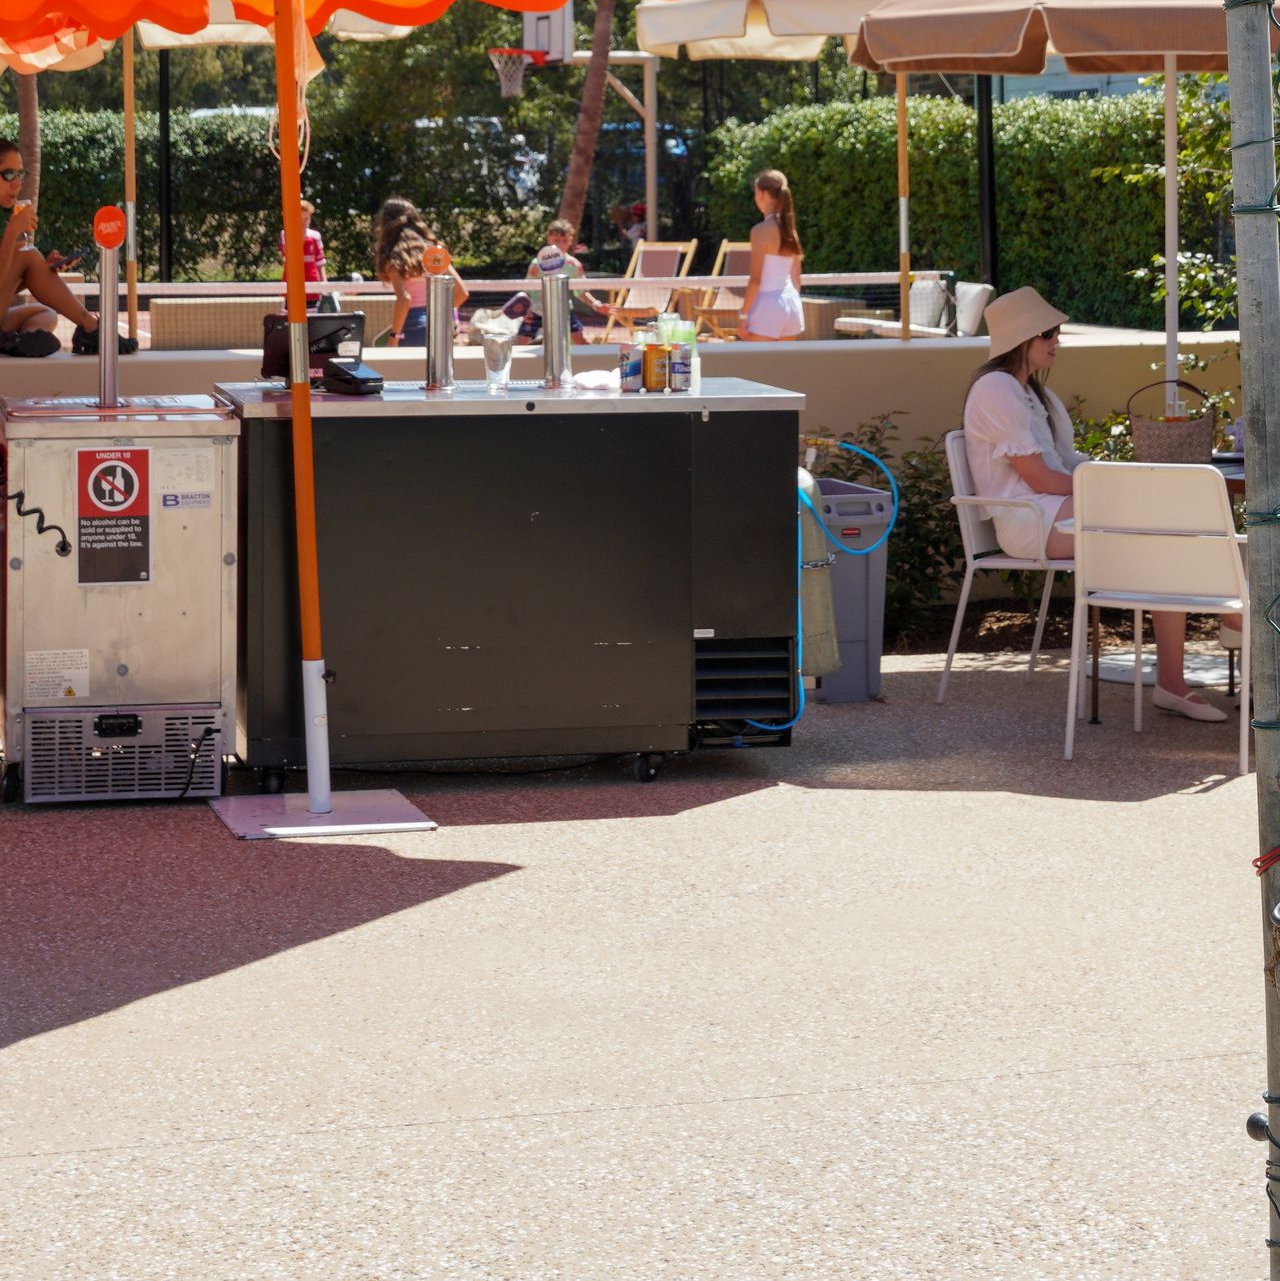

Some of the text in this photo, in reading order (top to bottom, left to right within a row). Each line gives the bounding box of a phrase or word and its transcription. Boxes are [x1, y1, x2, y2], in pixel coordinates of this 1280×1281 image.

[162, 494, 180, 507] B
[92, 518, 116, 526] alcohol
[105, 526, 134, 534] supplied
[92, 541, 117, 549] against
